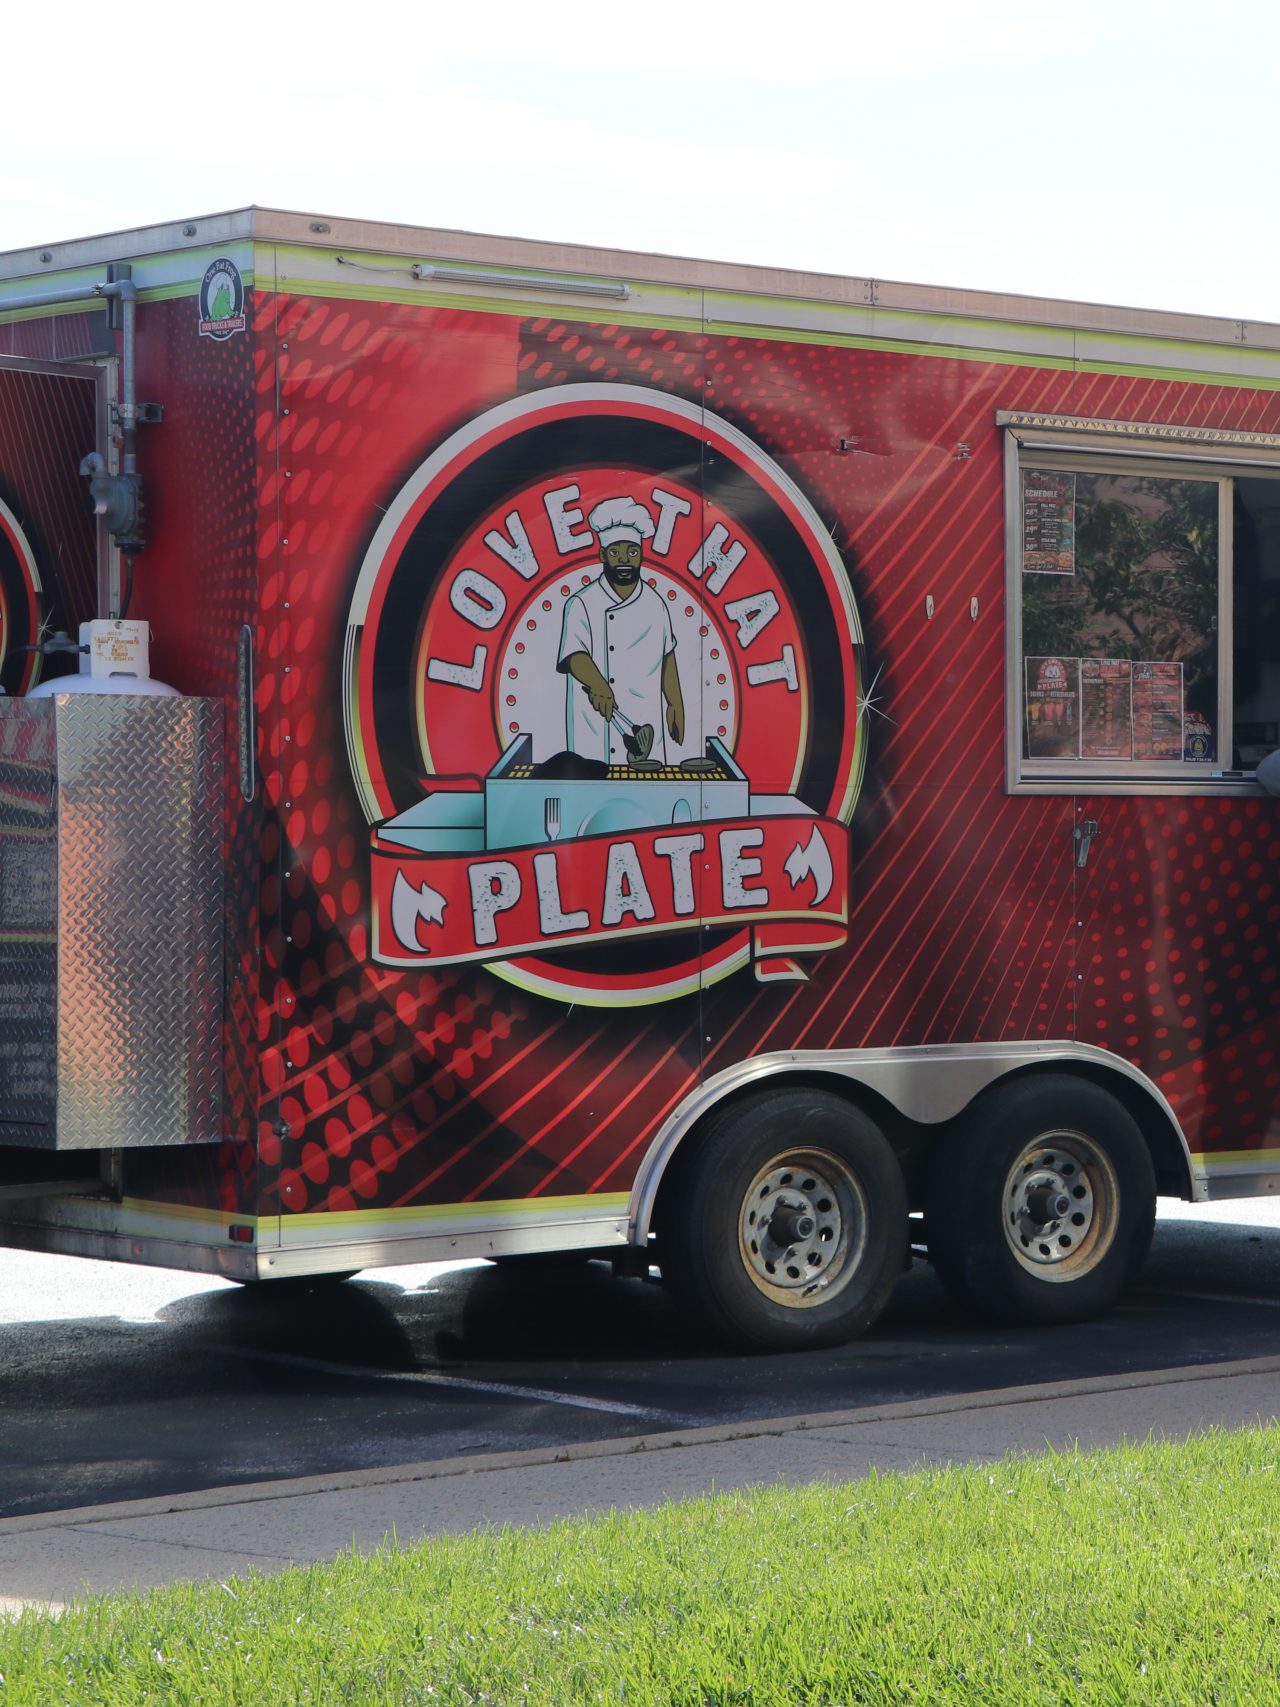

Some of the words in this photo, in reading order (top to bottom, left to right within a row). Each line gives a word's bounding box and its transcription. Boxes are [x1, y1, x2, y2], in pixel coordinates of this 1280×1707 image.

[205, 268, 216, 283] One
[216, 261, 225, 271] Fat
[225, 261, 237, 281] Frog
[1025, 489, 1058, 498] SCHEDULE
[427, 484, 595, 691] LOVE
[650, 488, 800, 692] THAT
[1042, 681, 1063, 690] PLATE
[468, 828, 769, 945] PLATE
